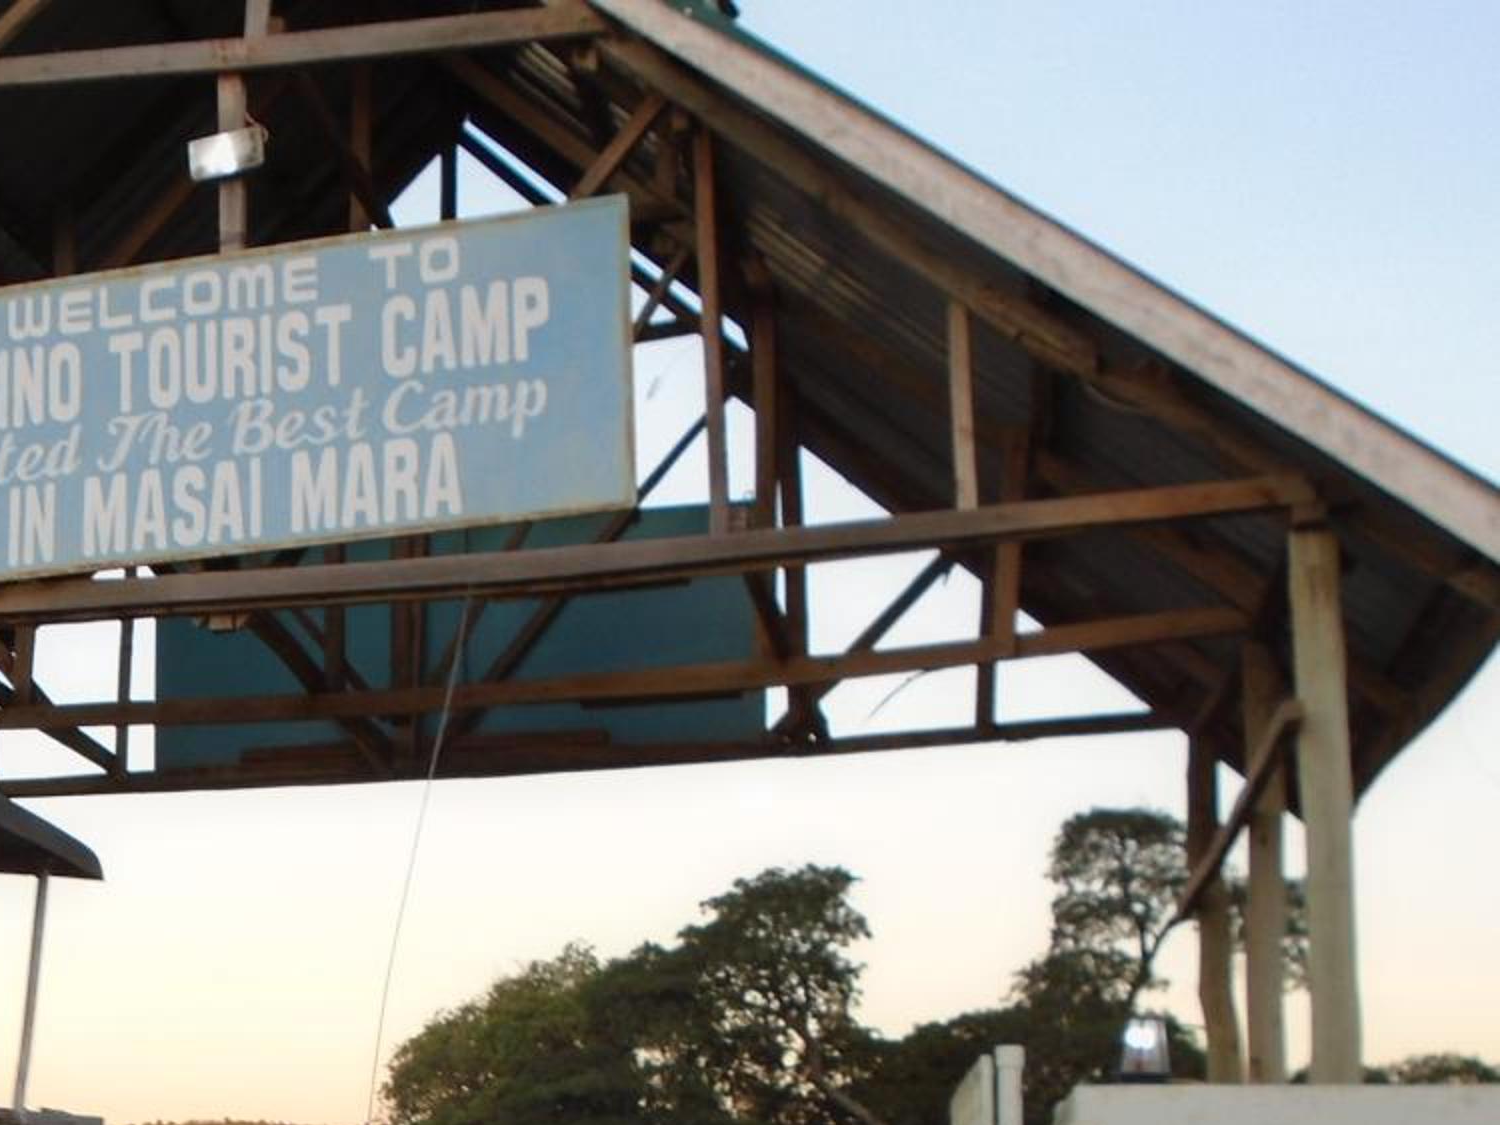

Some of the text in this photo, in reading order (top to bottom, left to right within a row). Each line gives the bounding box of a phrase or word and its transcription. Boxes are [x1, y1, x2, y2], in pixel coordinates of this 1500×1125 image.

[7, 236, 460, 341] WELCOME TO
[108, 304, 351, 414] TOURIST
[381, 276, 550, 380] CAMP
[95, 411, 213, 473] The
[231, 390, 365, 455] Best
[381, 376, 549, 440] Camp
[7, 431, 463, 568] IN MASAI MARA
